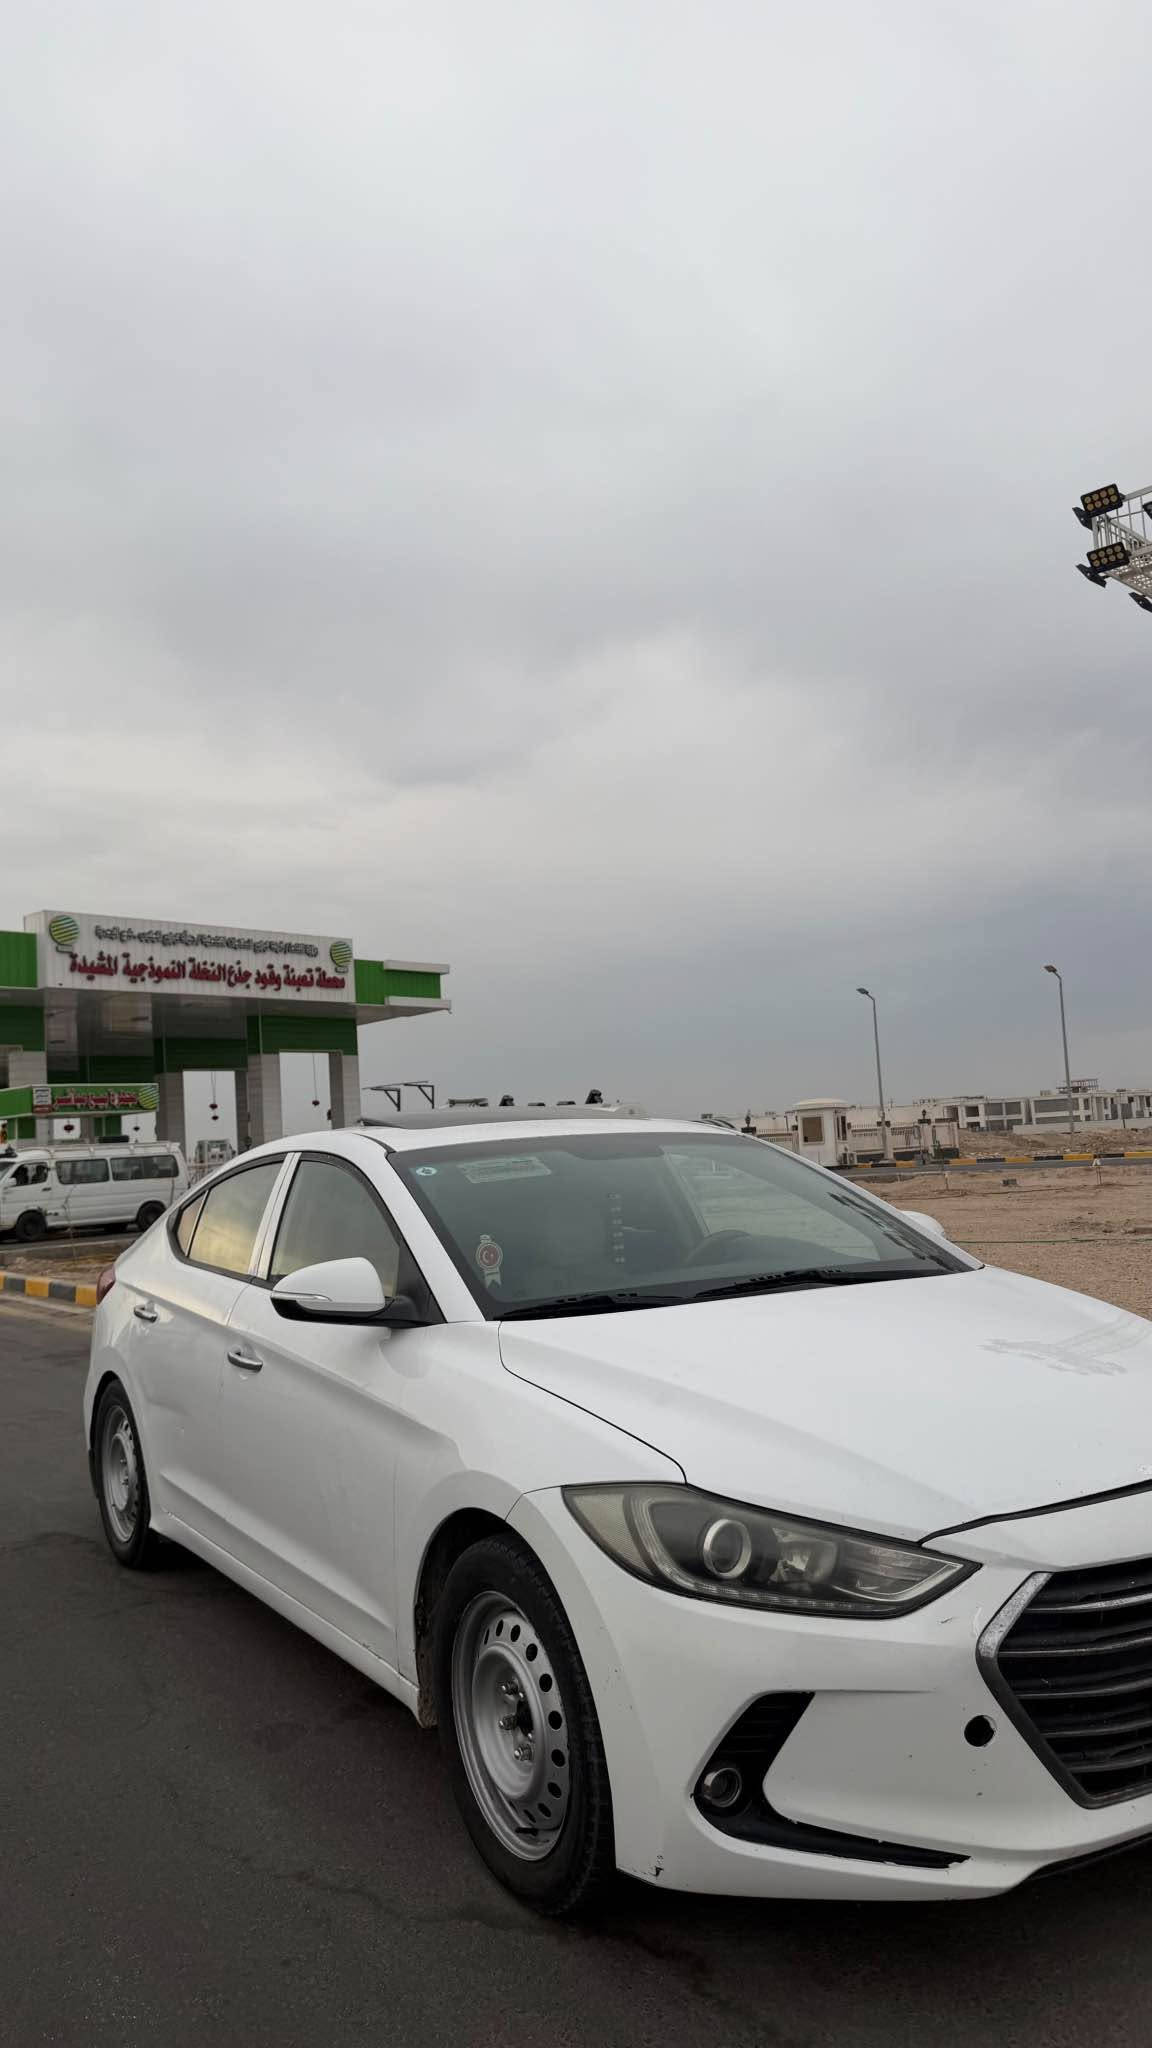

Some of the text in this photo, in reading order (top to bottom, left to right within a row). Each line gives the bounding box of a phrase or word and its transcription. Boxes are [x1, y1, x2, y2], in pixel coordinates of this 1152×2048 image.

[69, 950, 346, 992] محطة تعبئة وقود جذع النخلة النموذجية المشيدة
